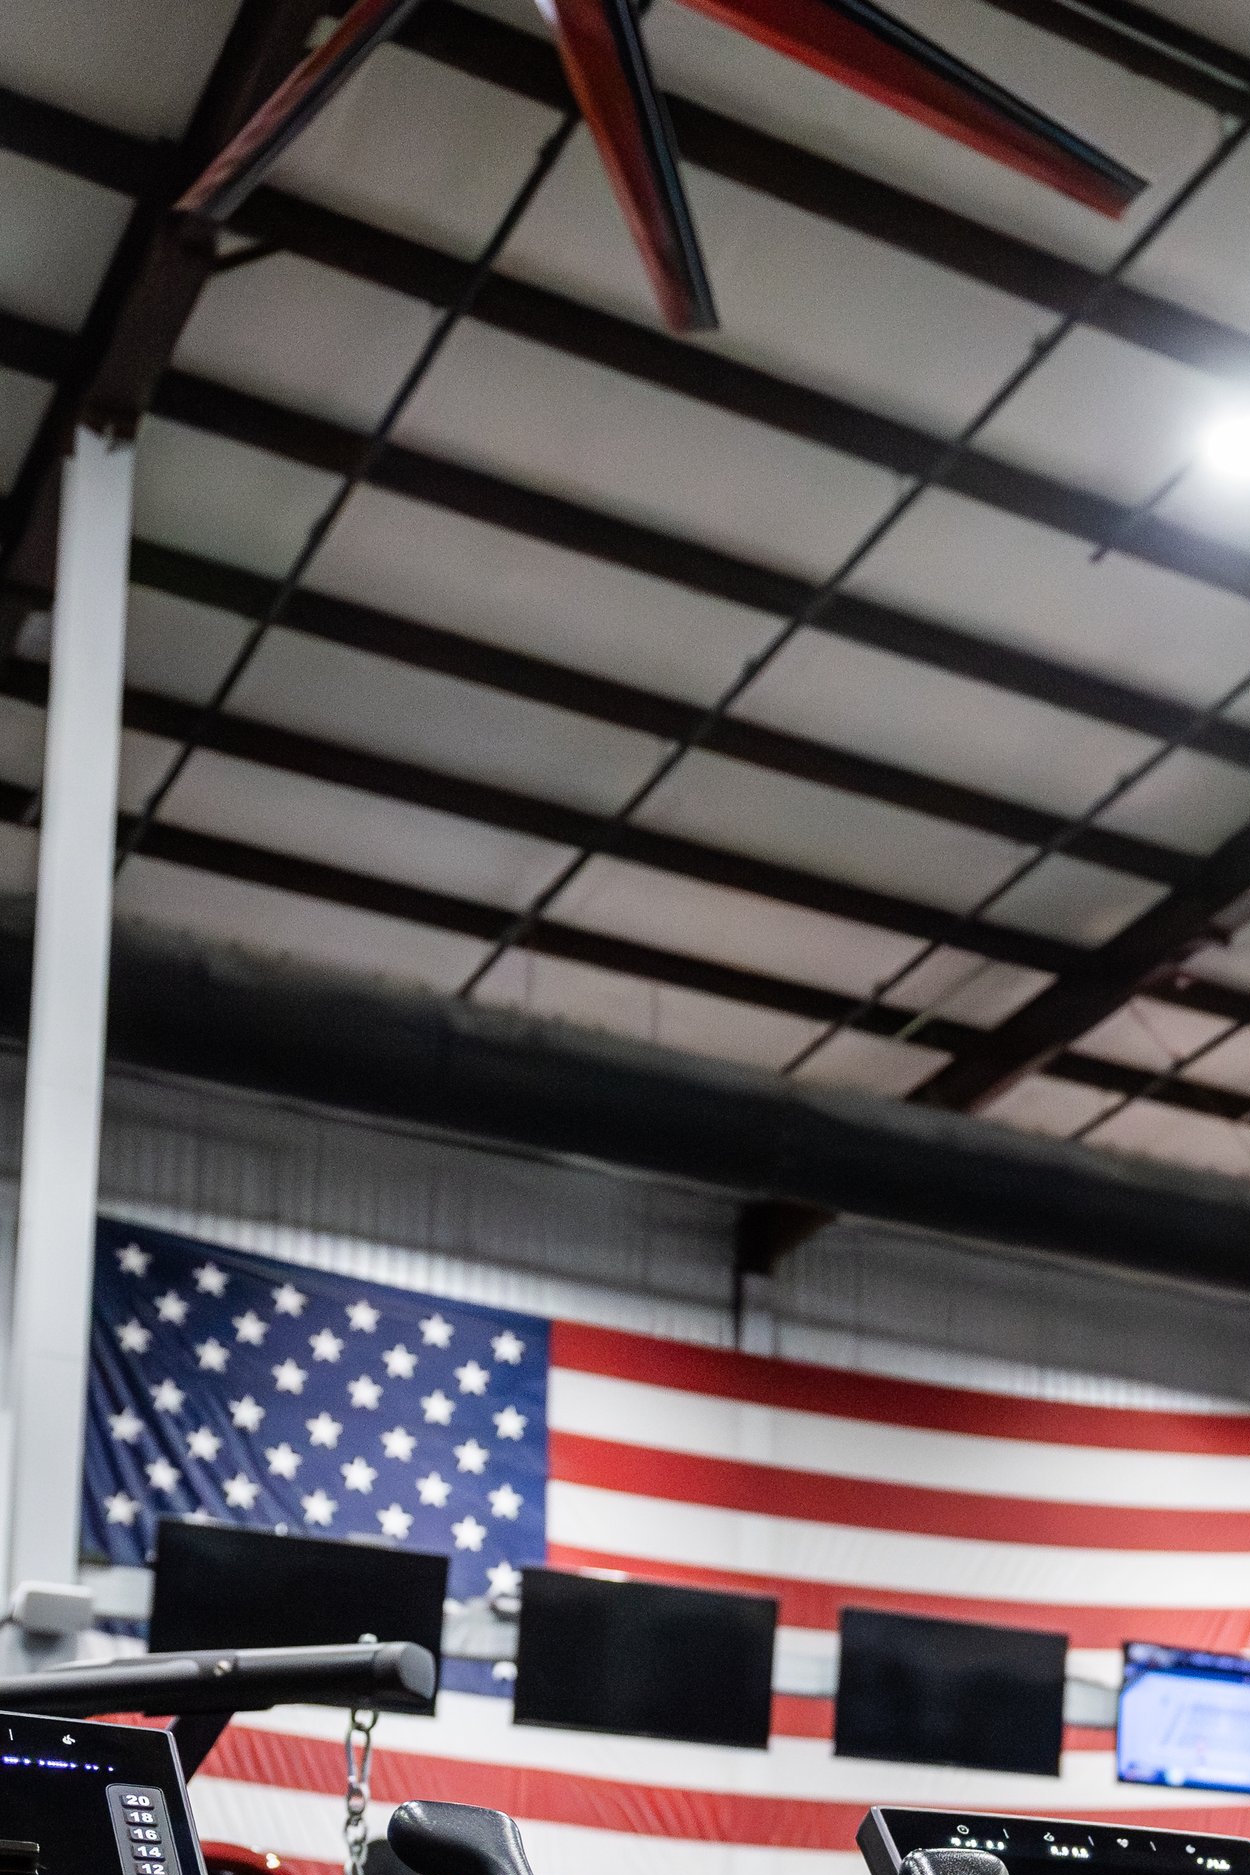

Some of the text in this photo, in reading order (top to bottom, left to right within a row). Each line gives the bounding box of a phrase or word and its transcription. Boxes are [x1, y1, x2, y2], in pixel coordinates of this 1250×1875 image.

[126, 1794, 150, 1806] 20
[130, 1812, 153, 1824] 18
[133, 1828, 157, 1840] 16
[137, 1846, 161, 1858] 14
[142, 1864, 165, 1875] 12
